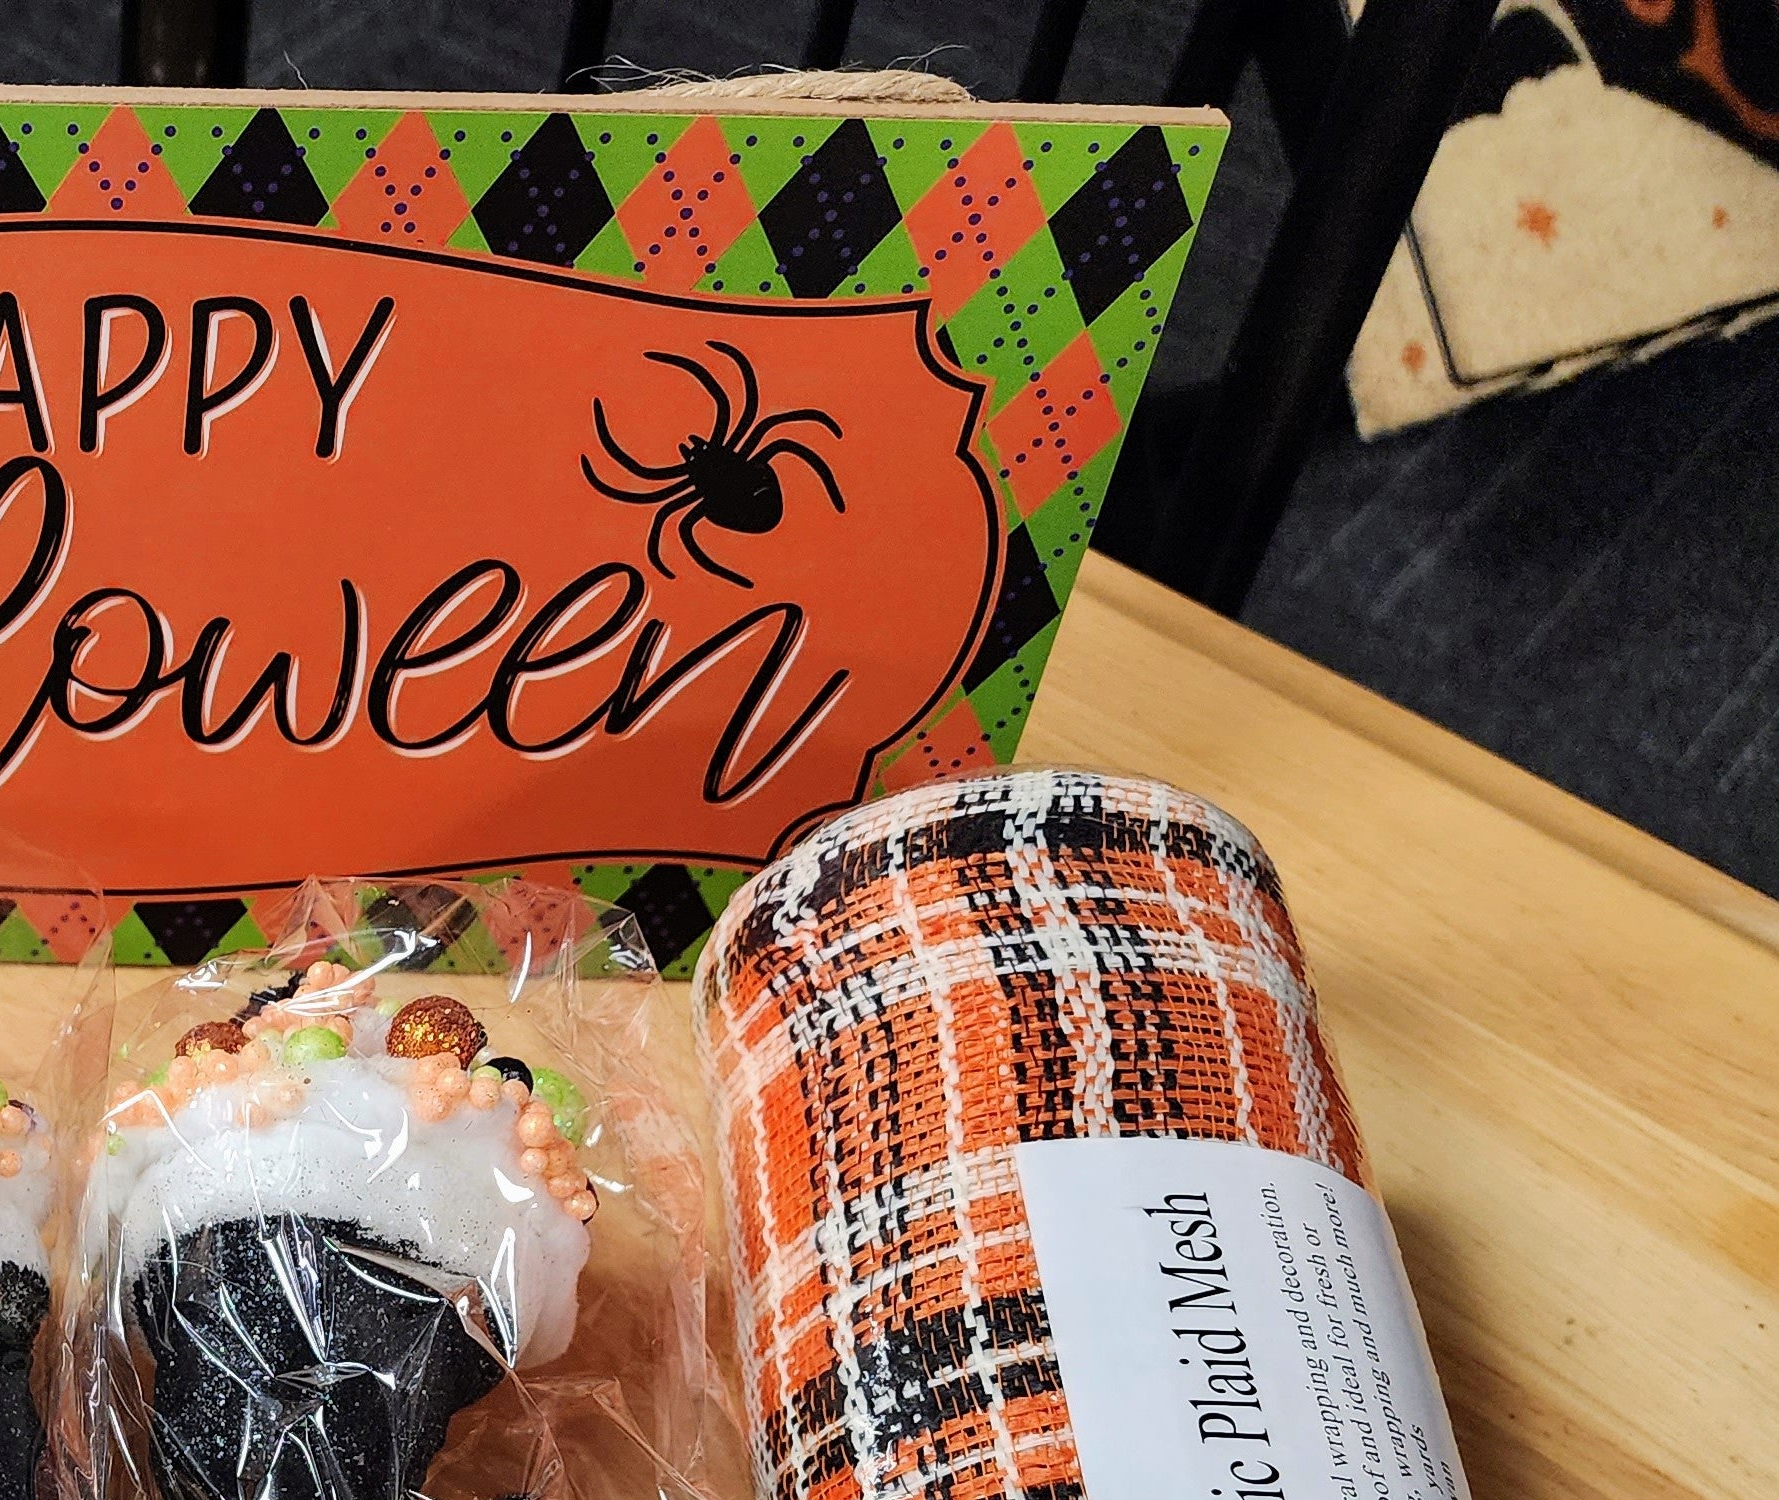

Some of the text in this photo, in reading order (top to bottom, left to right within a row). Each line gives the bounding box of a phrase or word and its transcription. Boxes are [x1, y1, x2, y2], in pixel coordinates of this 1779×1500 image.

[1259, 1182, 1305, 1304] decoration.
[1301, 1222, 1321, 1247] or
[1315, 1182, 1349, 1250] more!
[1142, 1191, 1239, 1315] Mesh
[1306, 1254, 1339, 1310] fresh
[1337, 1254, 1367, 1316] much
[1286, 1308, 1318, 1350] and
[1327, 1314, 1350, 1349] for
[1353, 1319, 1380, 1362] and
[1171, 1326, 1271, 1446] Plaid
[1305, 1356, 1349, 1467] wrapping
[1333, 1354, 1367, 1414] ideal
[1349, 1418, 1381, 1464] and
[1373, 1367, 1413, 1478] wrapping
[1409, 1424, 1443, 1494] yards
